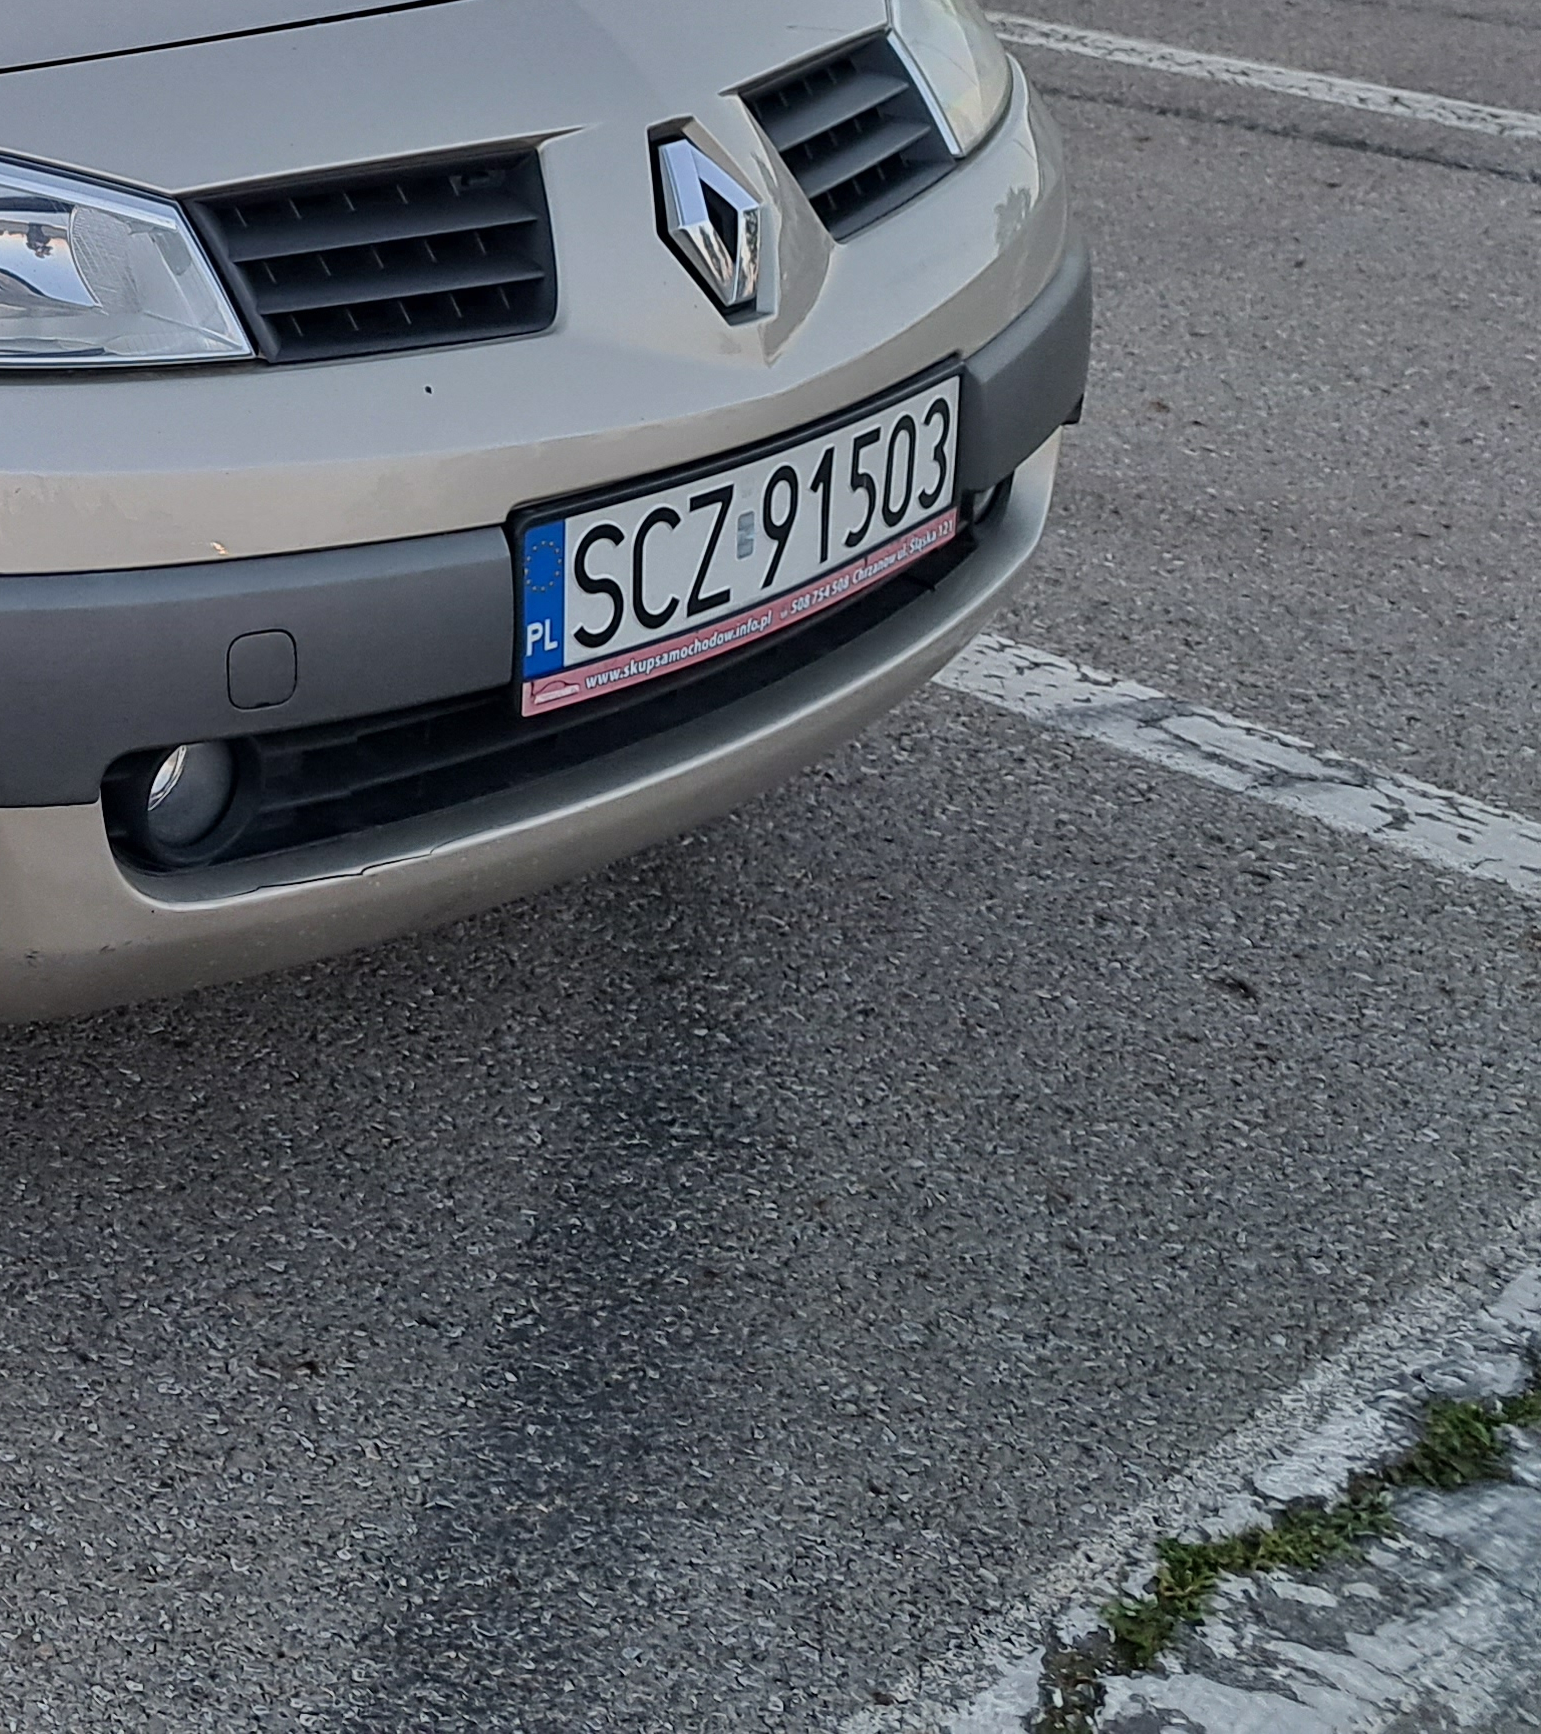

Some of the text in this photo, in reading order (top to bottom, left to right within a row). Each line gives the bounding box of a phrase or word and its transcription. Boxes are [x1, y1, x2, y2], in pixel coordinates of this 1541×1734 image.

[572, 397, 951, 648] SCZ 91503
[585, 609, 773, 690] www.skupsamochodow.info.pl
[790, 593, 811, 615] 508
[811, 584, 831, 605] 754
[831, 574, 850, 596] 508
[938, 519, 953, 537] 121
[525, 618, 559, 657] PL
